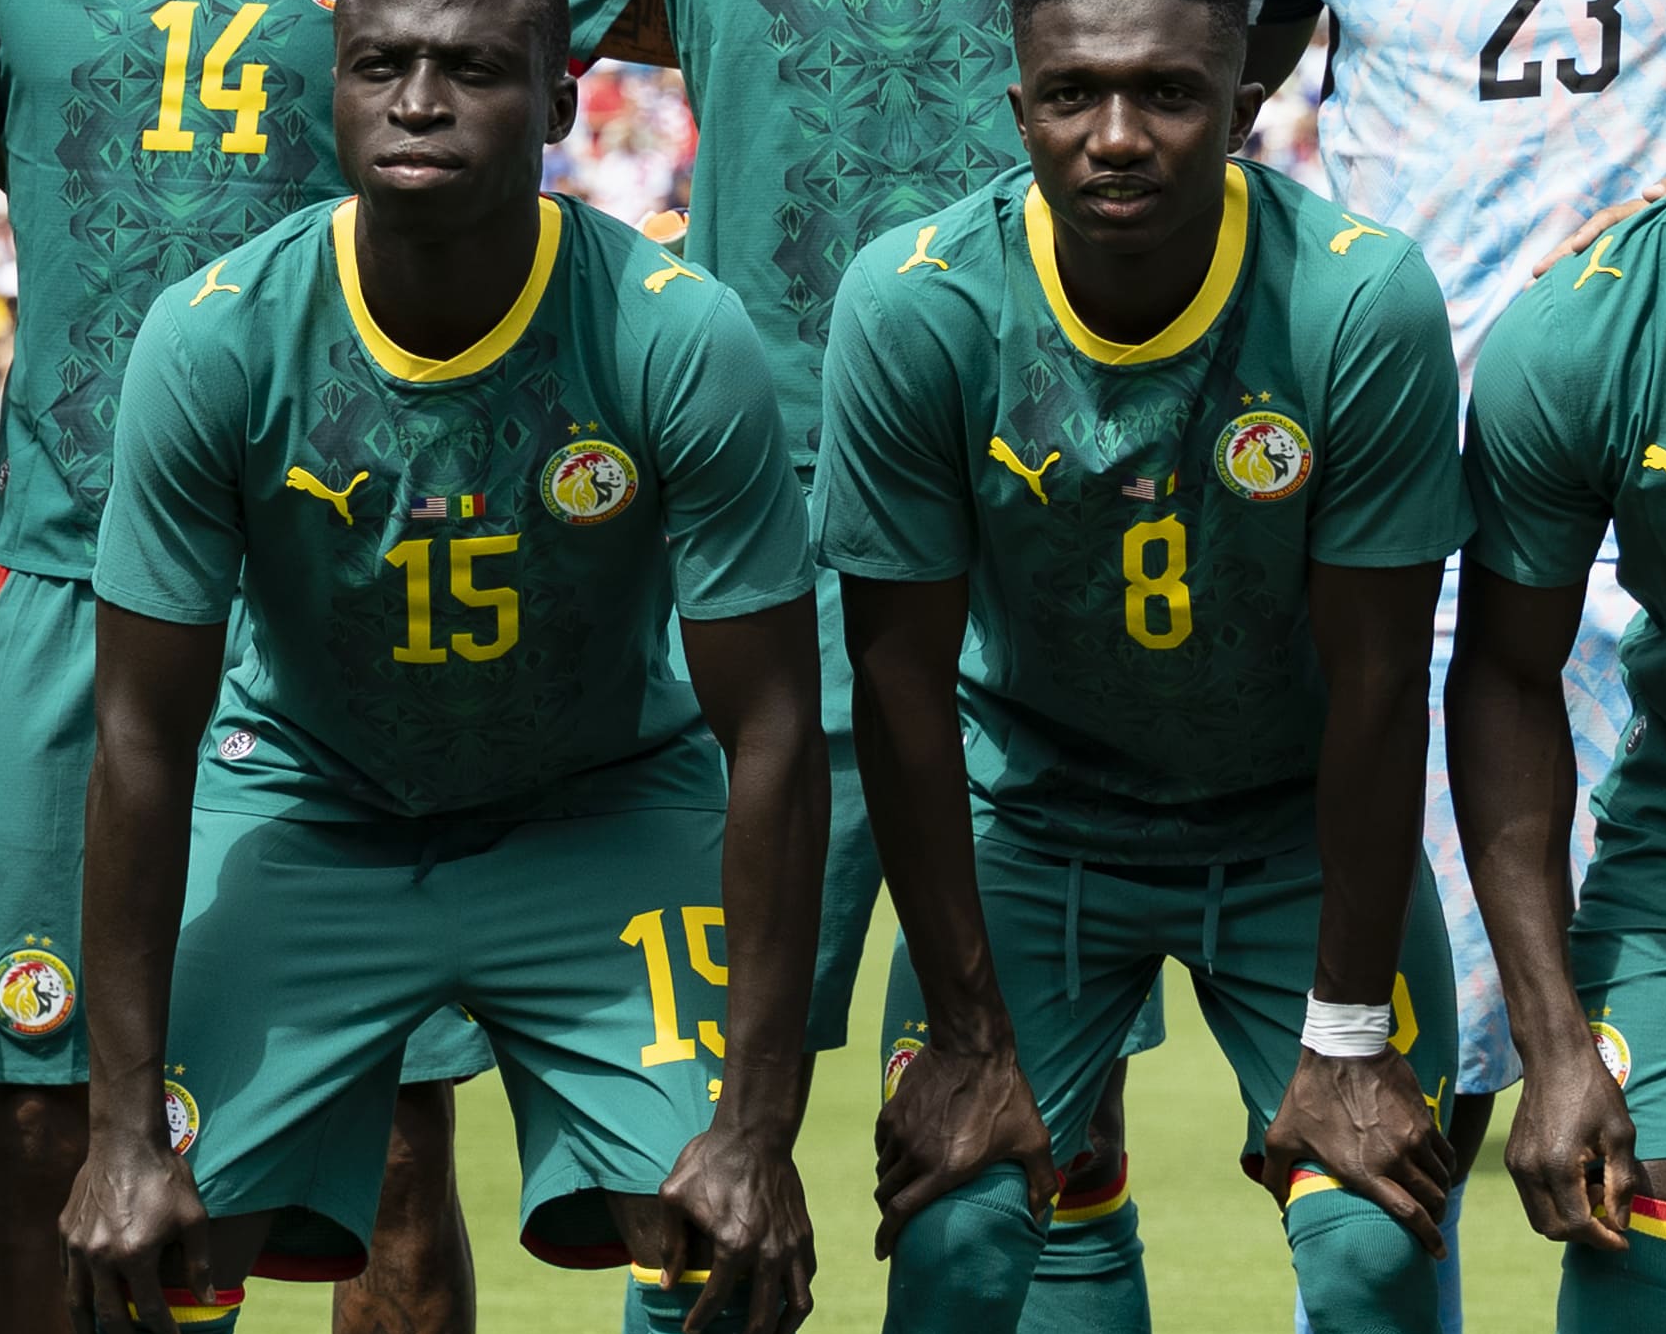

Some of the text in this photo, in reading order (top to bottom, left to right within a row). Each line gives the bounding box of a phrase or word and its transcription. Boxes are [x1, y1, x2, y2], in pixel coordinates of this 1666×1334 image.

[141, 0, 269, 155] 14
[385, 533, 520, 663] 15
[1122, 512, 1193, 650] 8
